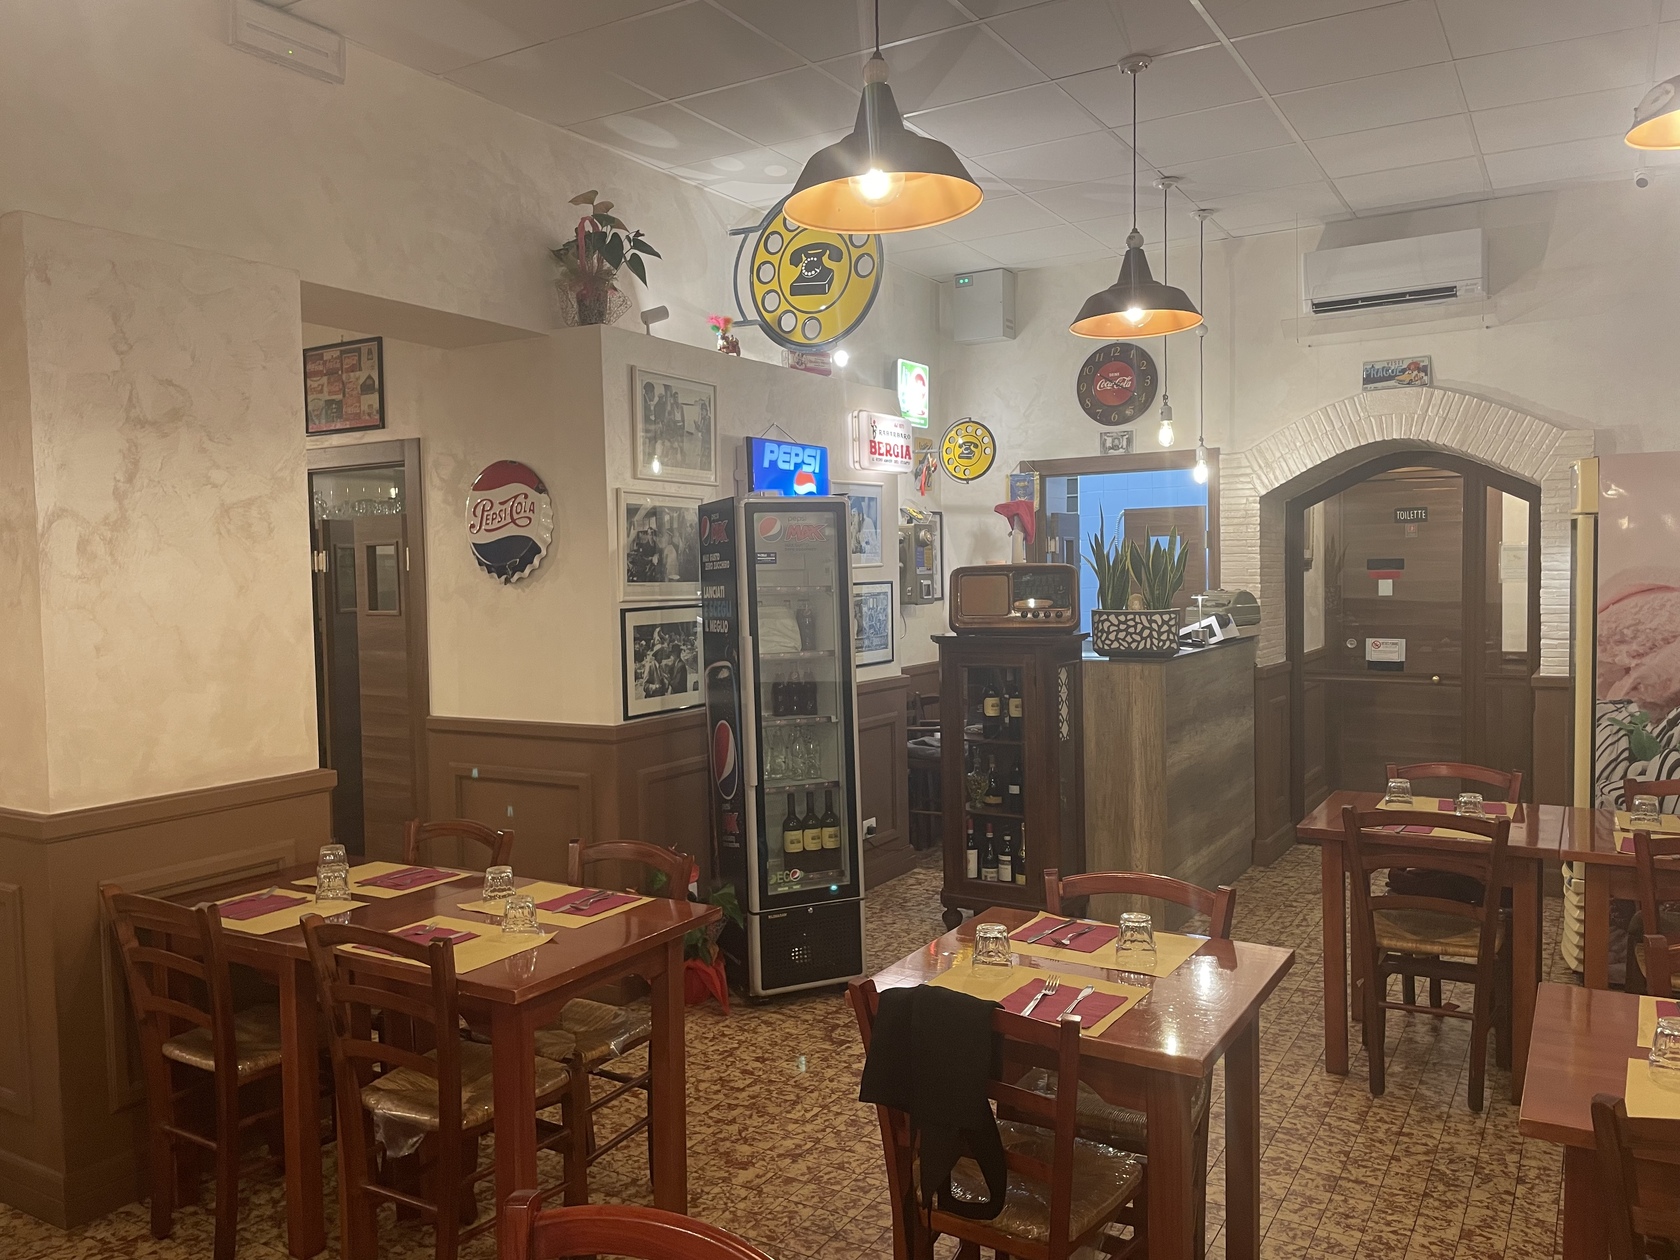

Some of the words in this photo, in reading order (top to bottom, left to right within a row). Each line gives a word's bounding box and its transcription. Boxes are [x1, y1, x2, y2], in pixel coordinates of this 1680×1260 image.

[1095, 352, 1104, 361] 11
[1110, 346, 1121, 356] 12
[1083, 365, 1095, 376] 10
[1140, 360, 1147, 370] 2
[1364, 365, 1404, 378] PRAGUE
[1144, 375, 1151, 386] 3
[1080, 383, 1087, 392] 9
[1084, 398, 1091, 408] 8
[1139, 392, 1146, 403] 4
[1096, 409, 1103, 419] 7
[1111, 411, 1118, 422] 6
[869, 439, 912, 461] BERGIA
[763, 442, 822, 473] PEPSI
[1396, 509, 1427, 520] TOILETTE
[784, 523, 828, 542] MAX
[703, 586, 725, 599] LANCIATI
[709, 600, 732, 617] SCEGLI
[709, 620, 729, 634] MEGLIO
